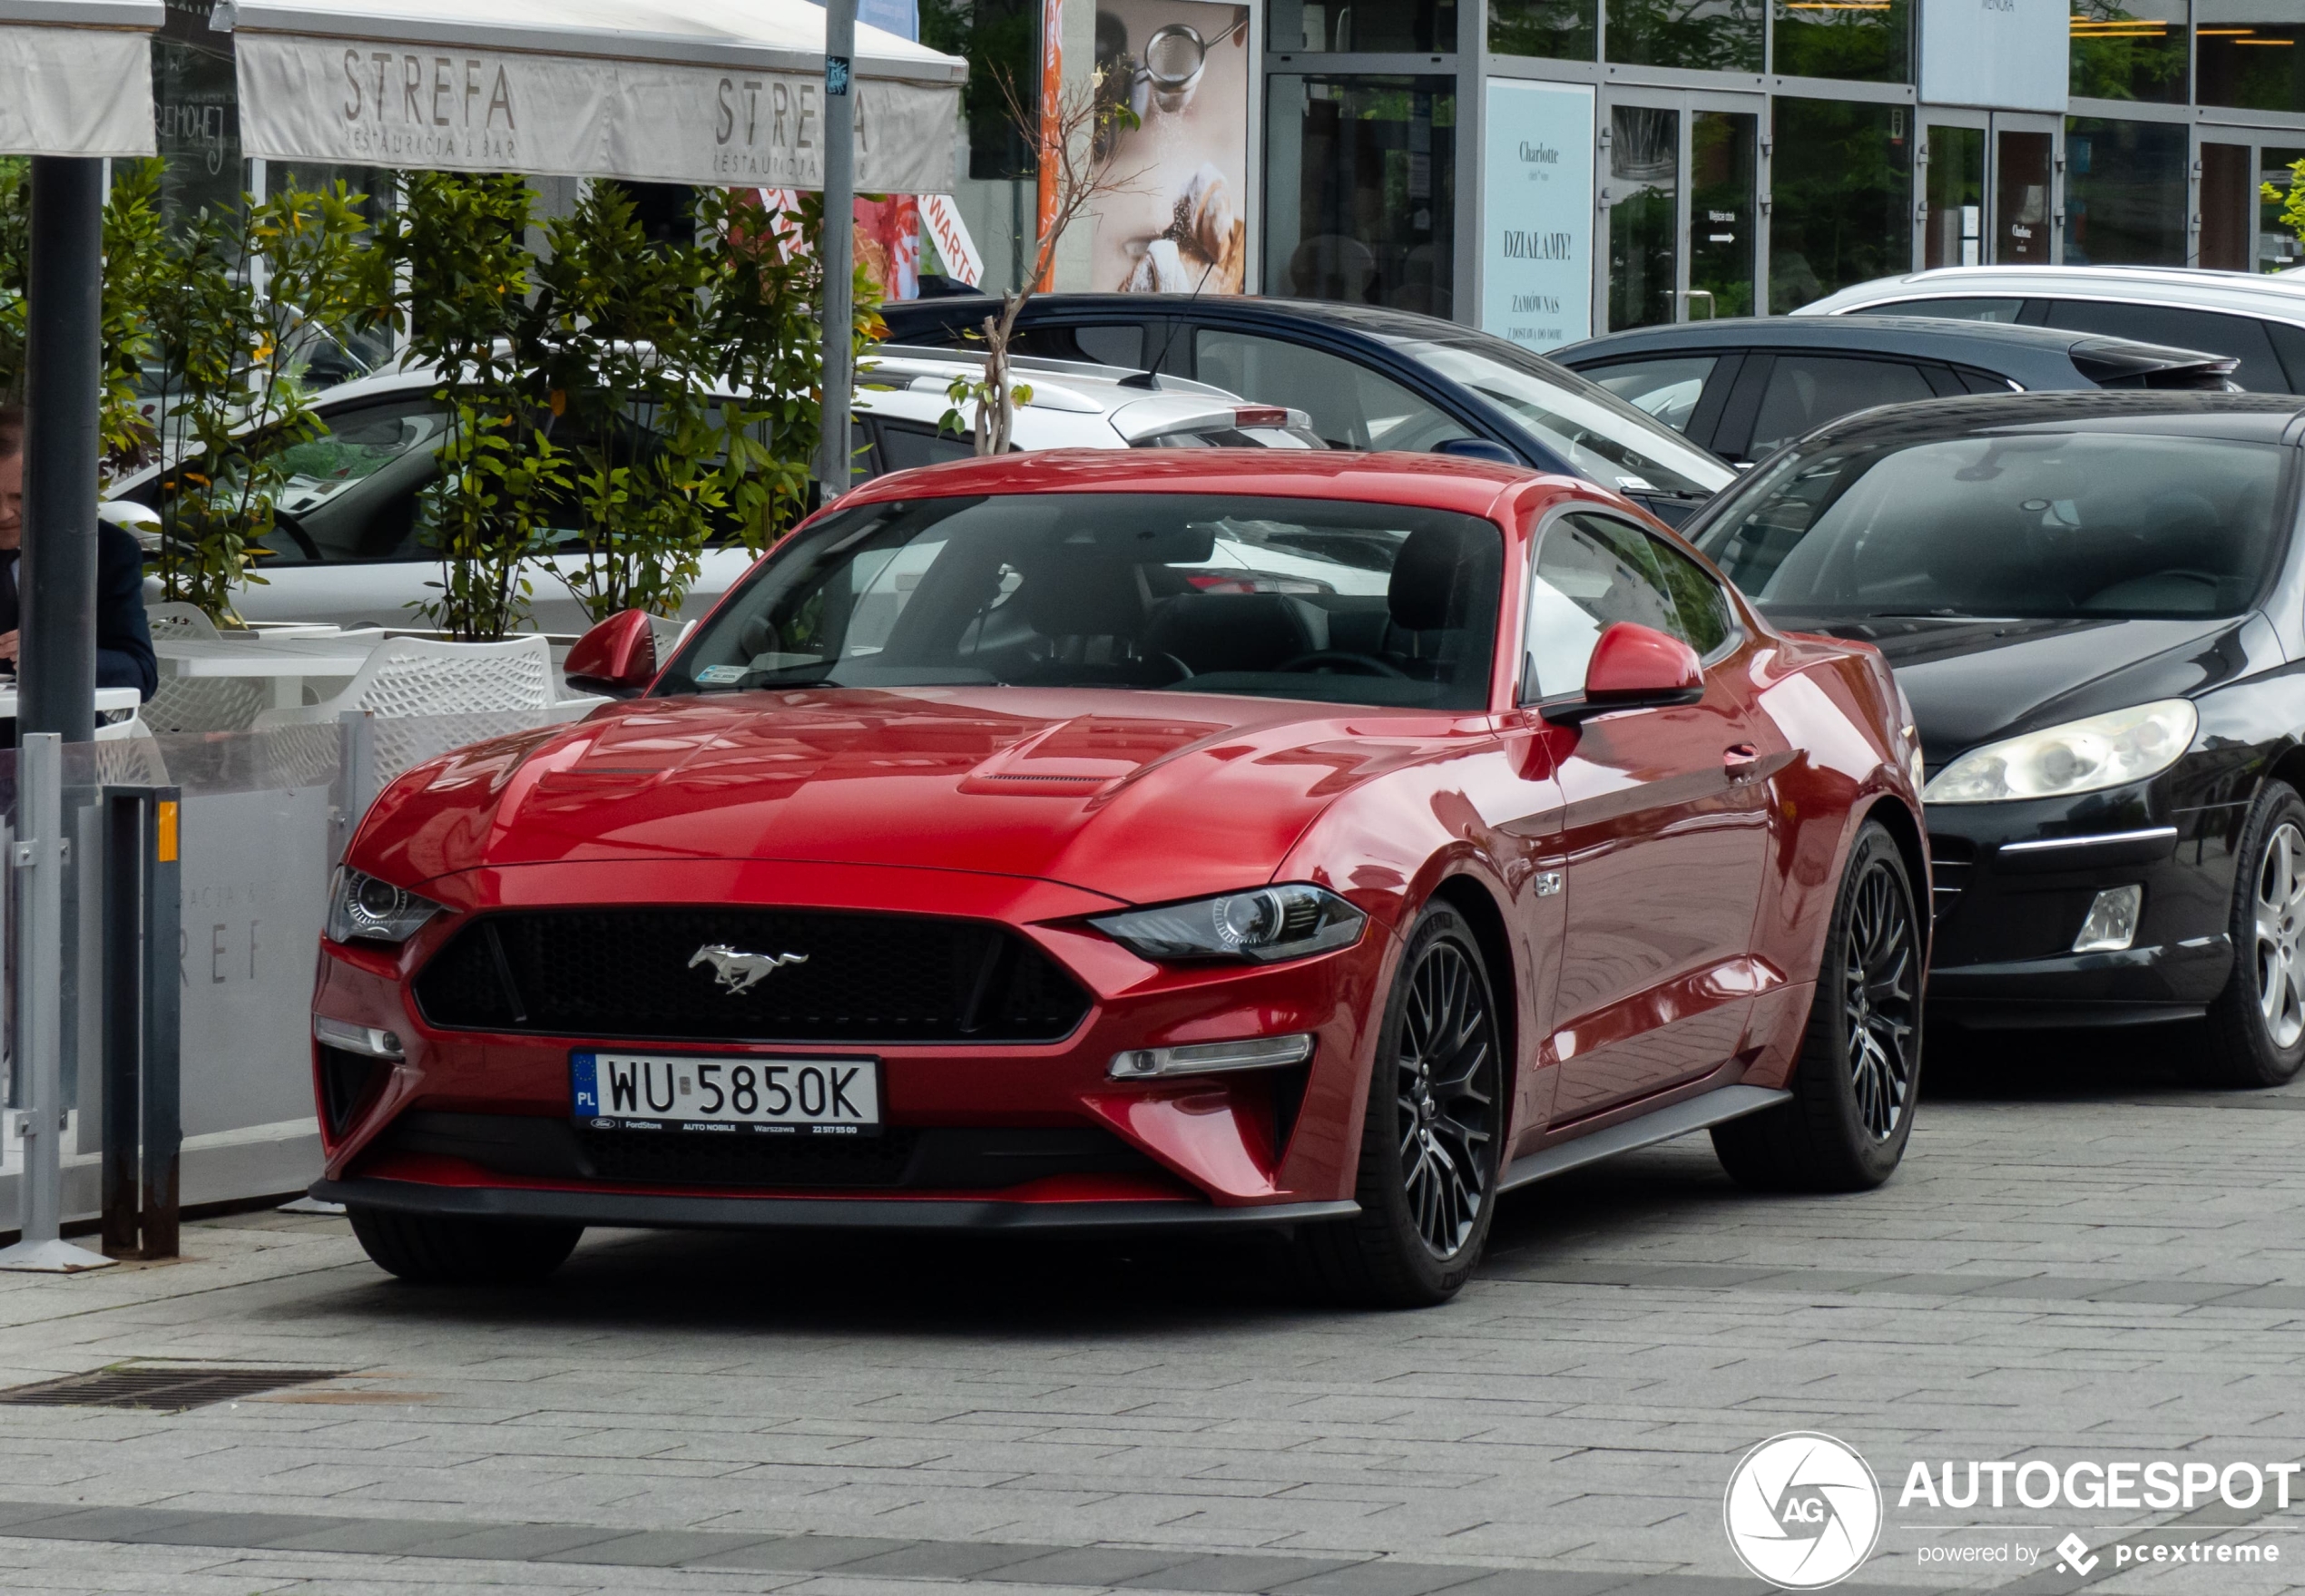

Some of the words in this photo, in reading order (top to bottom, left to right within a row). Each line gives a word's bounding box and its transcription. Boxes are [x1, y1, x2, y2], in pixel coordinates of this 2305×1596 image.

[344, 49, 515, 130] STREFA
[716, 78, 868, 152] STREA
[345, 131, 454, 155] RESTAURACJA
[483, 141, 515, 159] BAR
[1519, 141, 1559, 163] Charlotte
[1504, 230, 1571, 260] DZIAŁAMY!
[1512, 290, 1541, 313] ZAMÓW
[1544, 296, 1560, 314] NAS
[577, 1091, 595, 1106] PL
[608, 1060, 675, 1112] WU
[698, 1064, 862, 1118] 5850K
[625, 1121, 662, 1130] FordStore
[682, 1123, 704, 1131] AUTO
[705, 1123, 736, 1132] NOBILE
[753, 1125, 796, 1133] Warszawa
